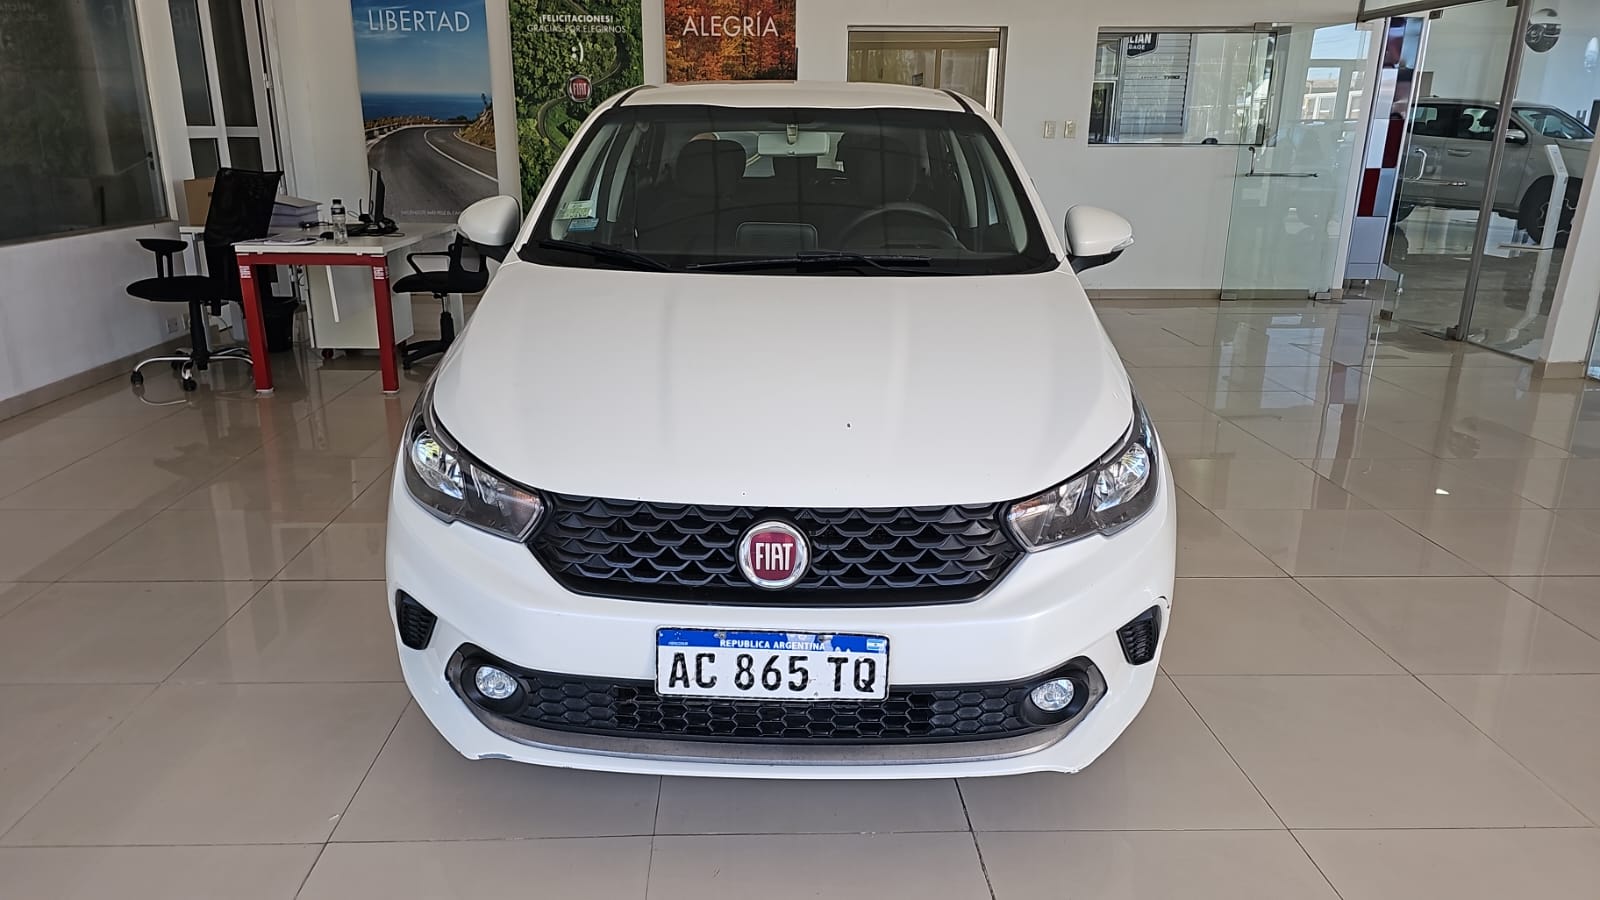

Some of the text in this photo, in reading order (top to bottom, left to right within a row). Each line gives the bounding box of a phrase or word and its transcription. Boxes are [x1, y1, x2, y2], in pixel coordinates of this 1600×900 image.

[368, 9, 470, 32] LIBERTAD
[539, 14, 614, 24] ¡FELICITACIONES!
[682, 10, 779, 37] ALEGRÍA
[526, 24, 626, 34] GRACIAS POR ELEGIRNOS
[573, 82, 587, 95] FIAT
[755, 542, 794, 571] FIAT
[719, 639, 826, 651] REPUBLICA ARGENTINA
[668, 652, 877, 693] AC 865 TQ
